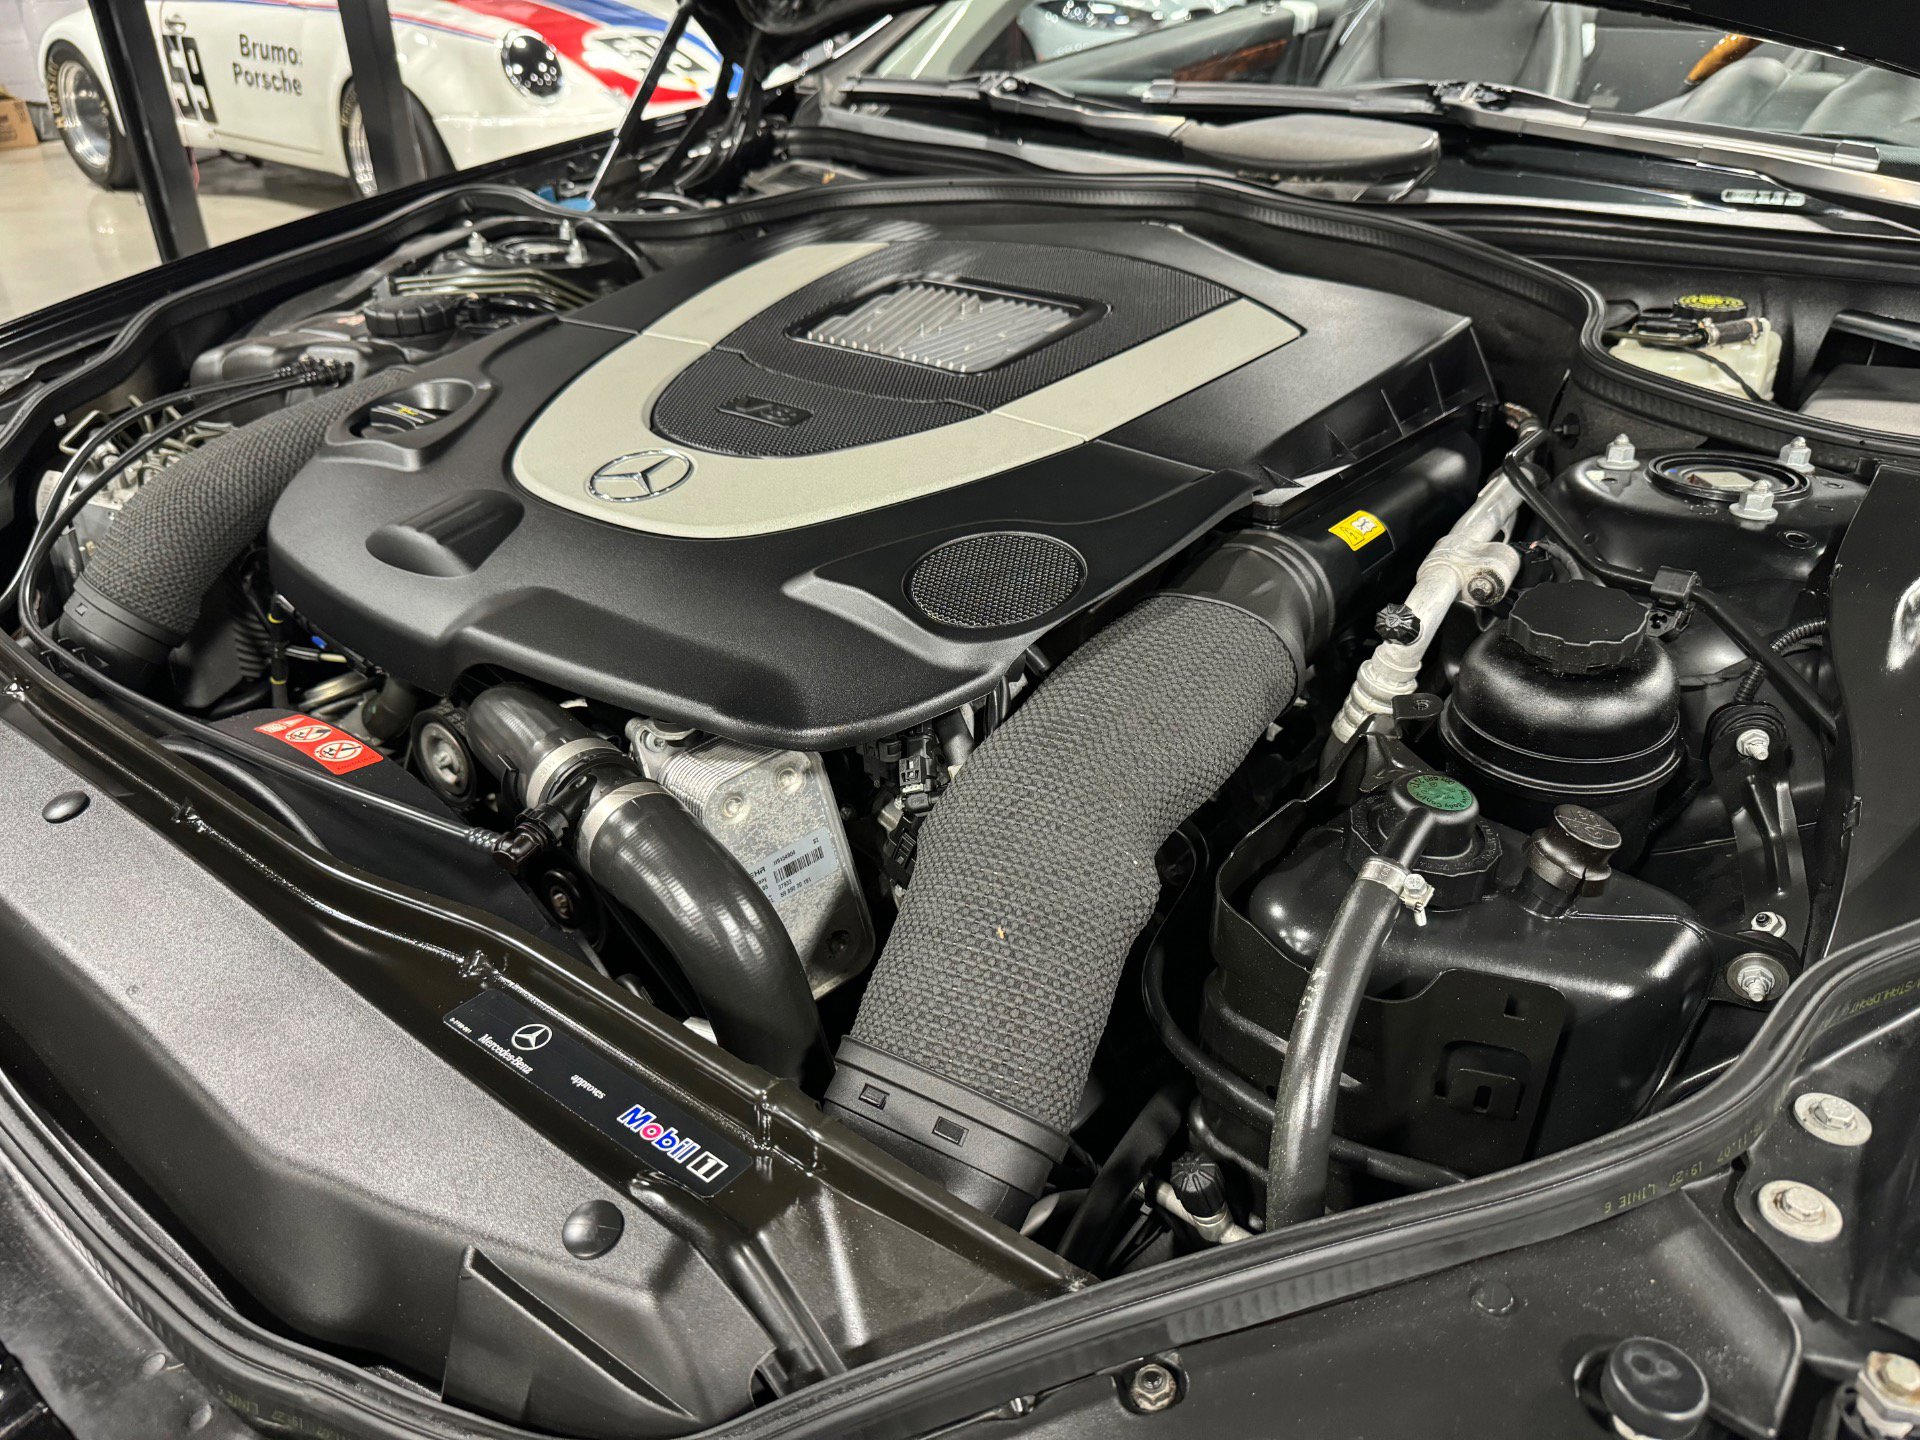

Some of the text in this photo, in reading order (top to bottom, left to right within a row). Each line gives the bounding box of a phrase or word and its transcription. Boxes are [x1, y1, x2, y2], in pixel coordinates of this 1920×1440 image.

[239, 33, 303, 66] Brumo
[232, 61, 303, 97] Porsche
[478, 1033, 534, 1075] Mercedes-Benz
[570, 1074, 606, 1100] approves
[616, 1104, 701, 1164] Mobil
[1604, 1204, 1612, 1213] 6
[1618, 1184, 1657, 1208] LINIE
